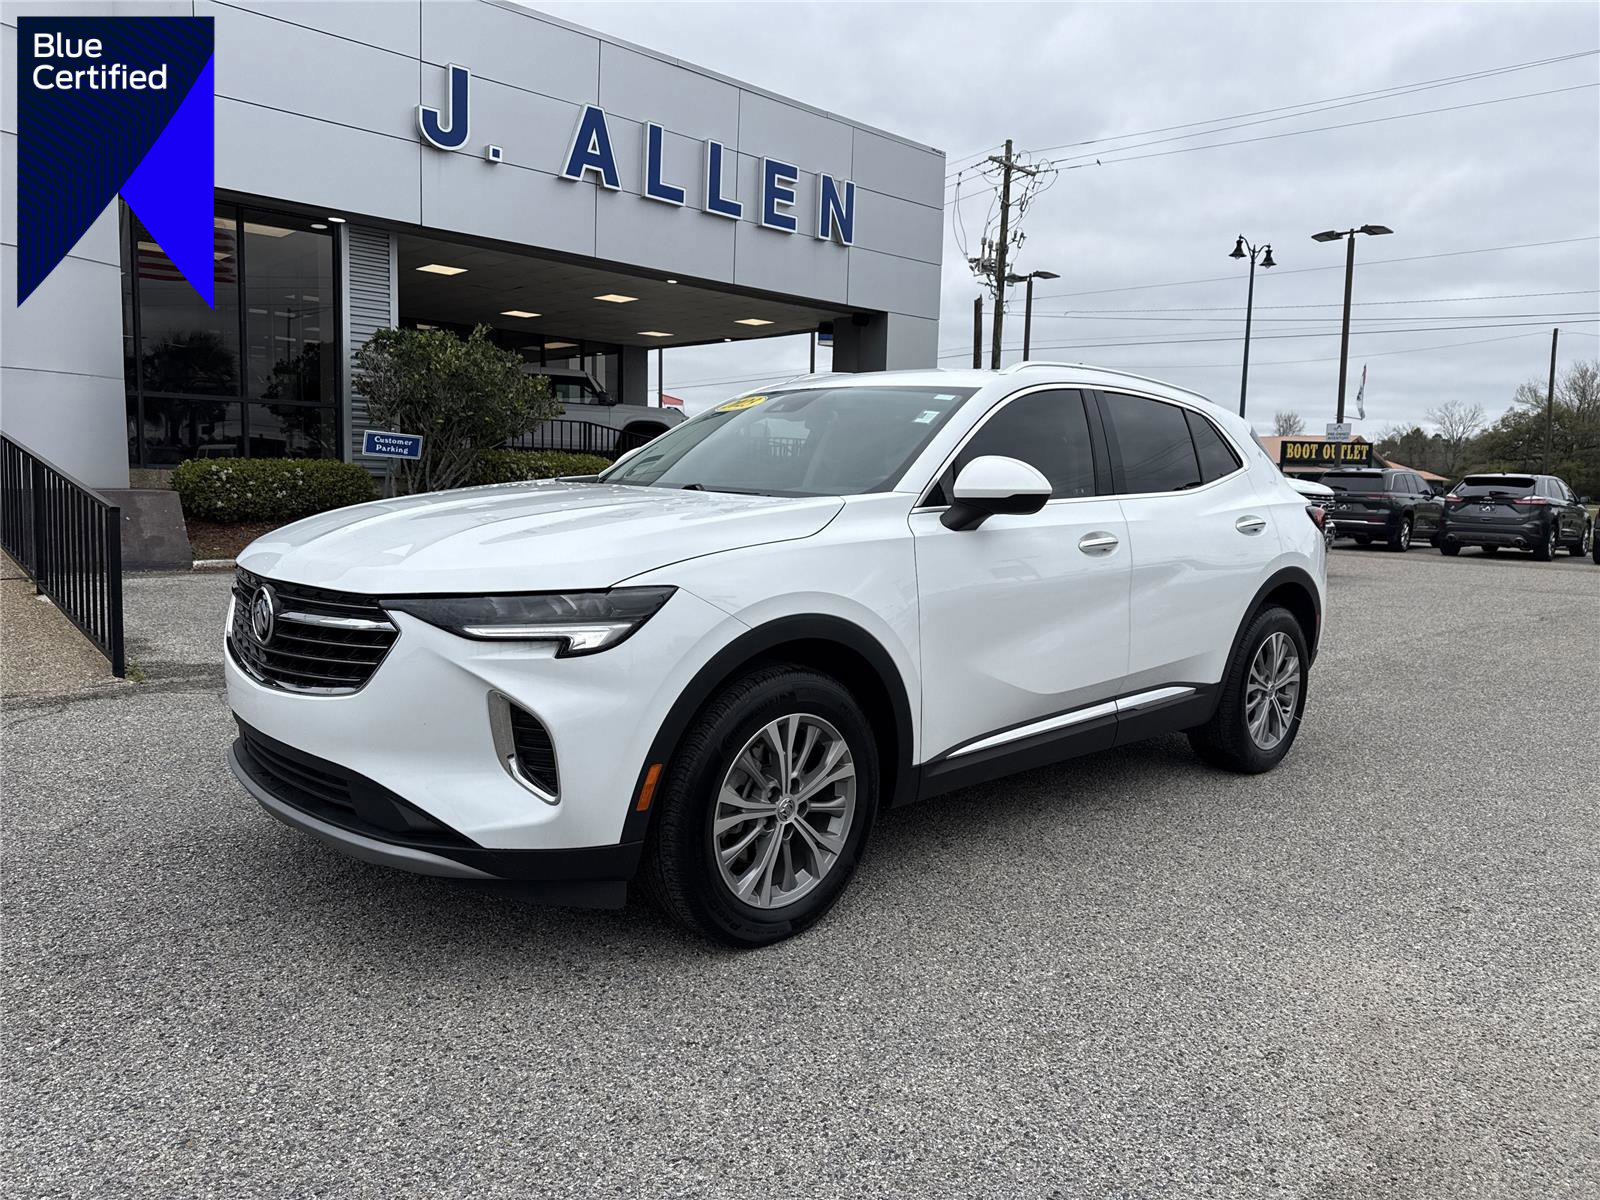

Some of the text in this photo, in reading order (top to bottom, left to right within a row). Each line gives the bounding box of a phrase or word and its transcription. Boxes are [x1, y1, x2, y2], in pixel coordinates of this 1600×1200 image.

[416, 63, 856, 246] J. ALLEN
[374, 436, 413, 445] Customer
[376, 444, 409, 455] Parking
[1286, 443, 1318, 458] BOOT
